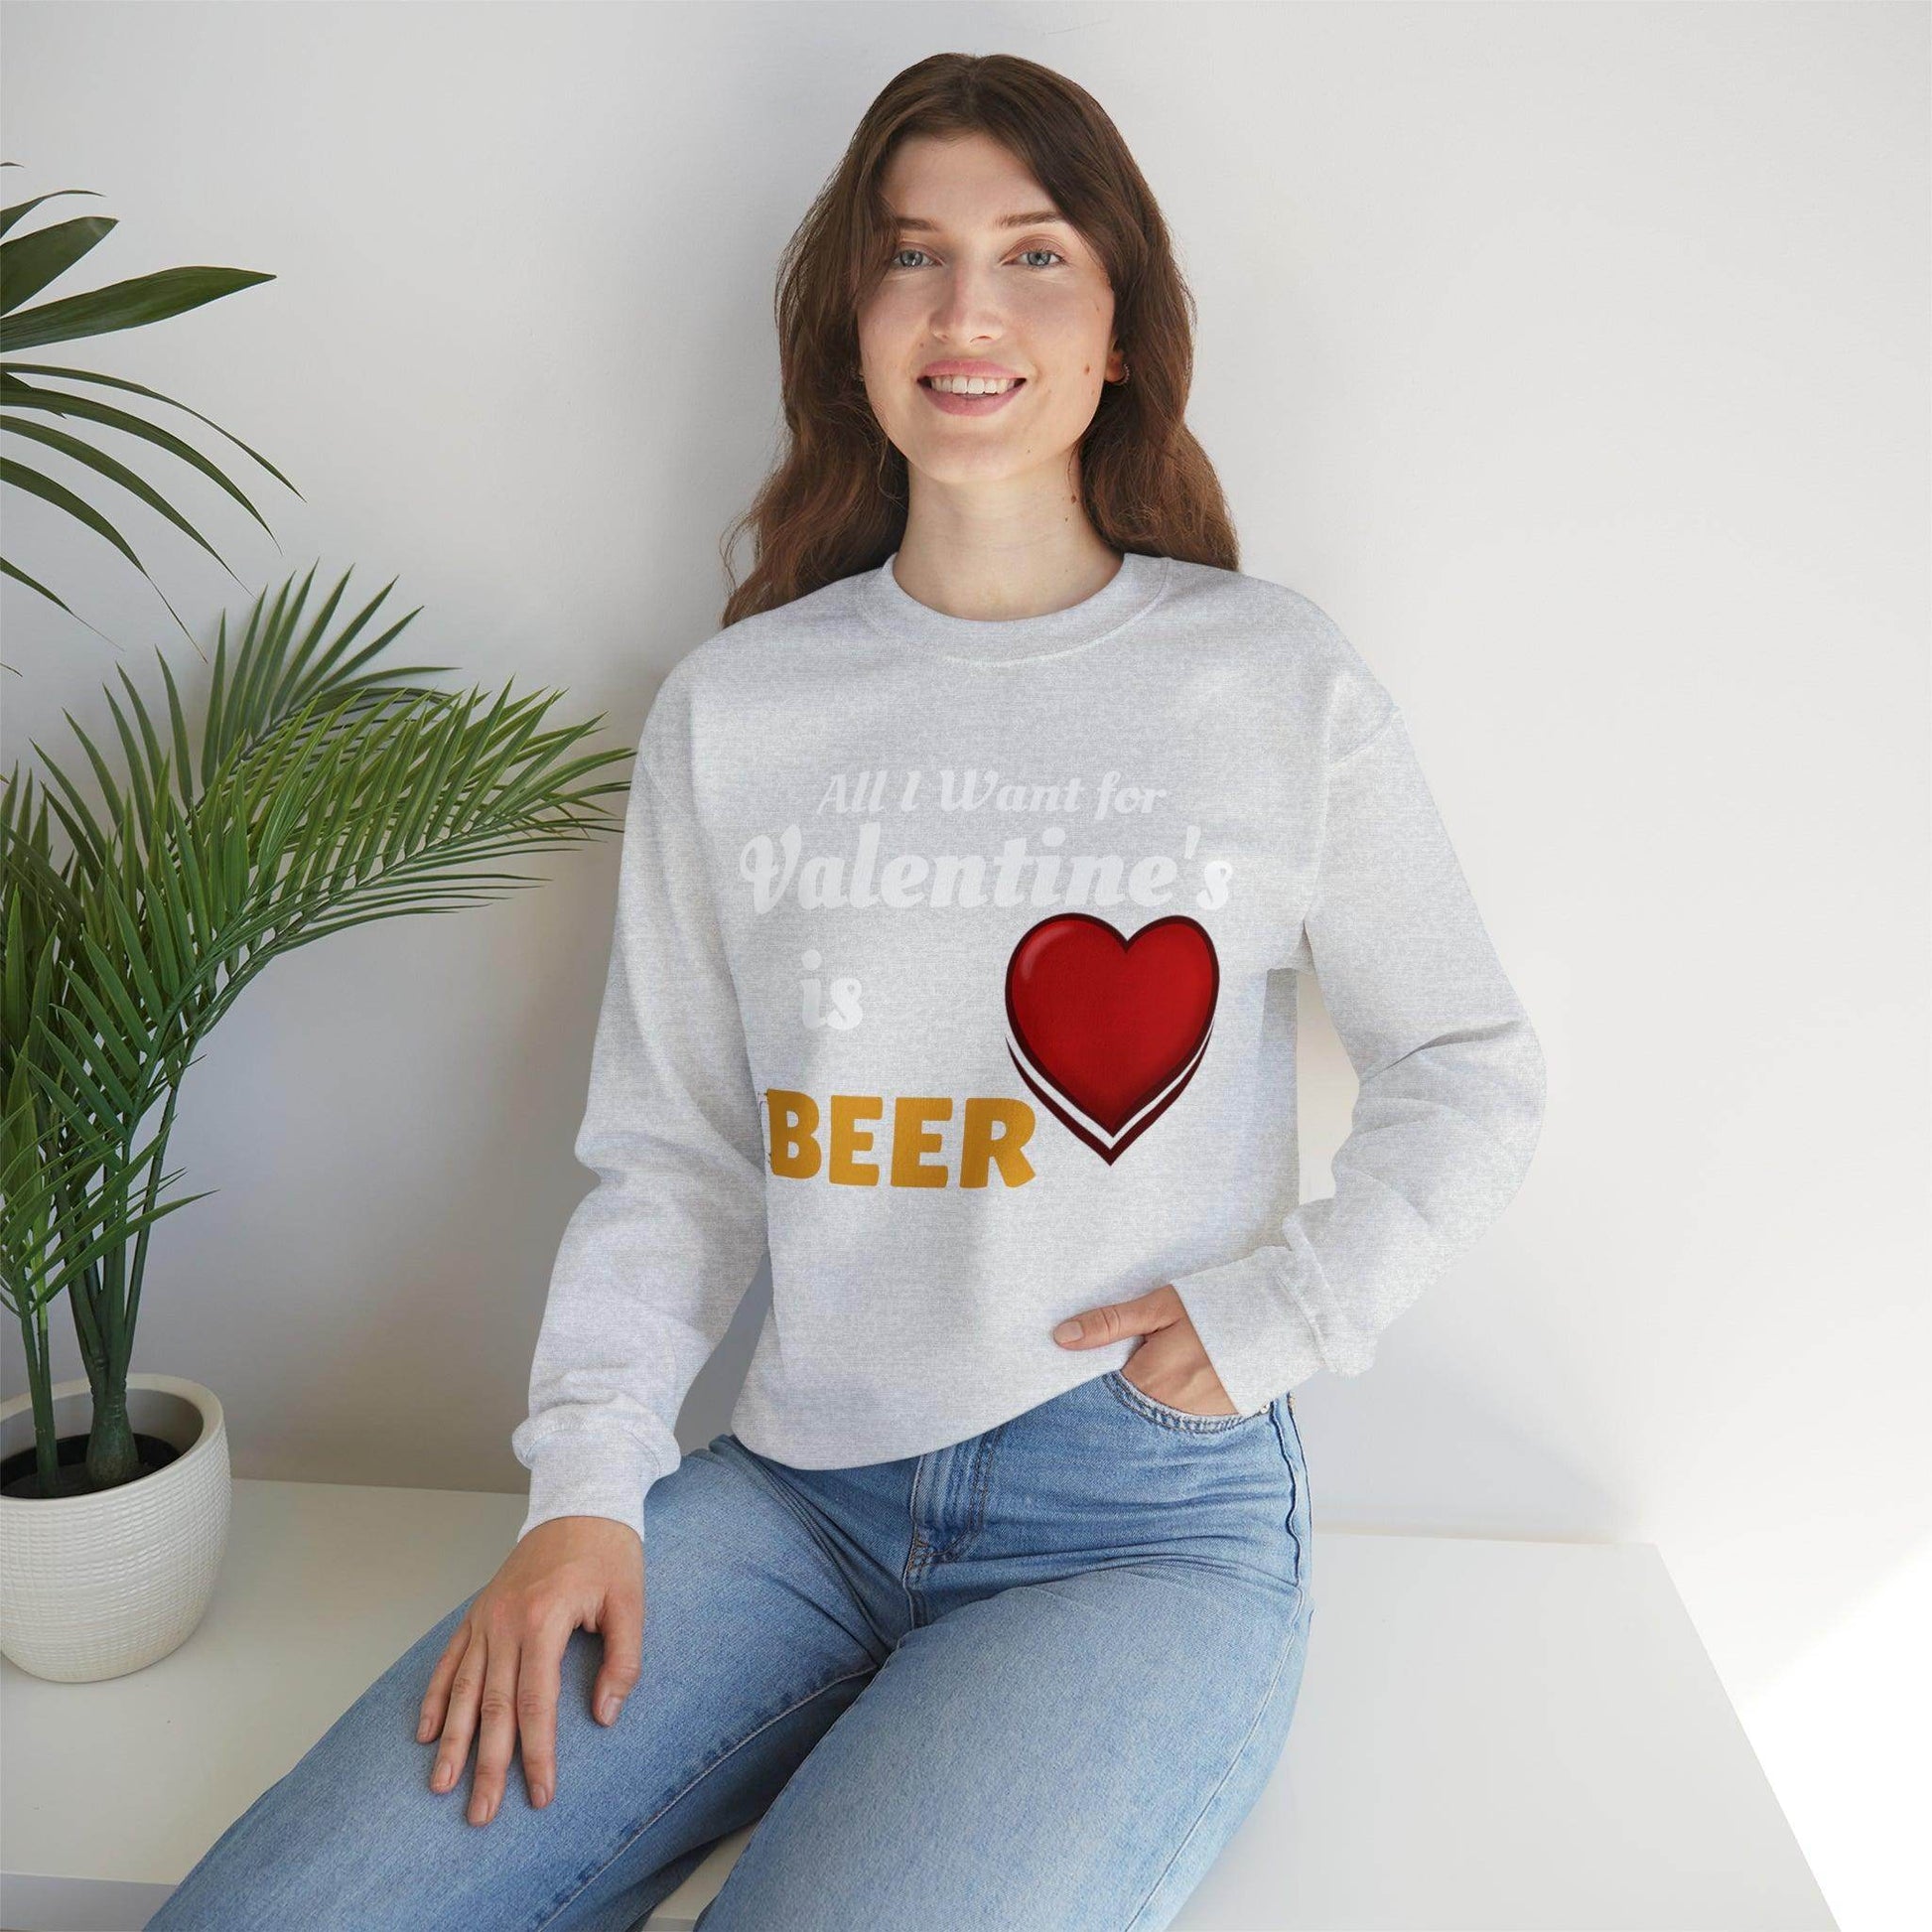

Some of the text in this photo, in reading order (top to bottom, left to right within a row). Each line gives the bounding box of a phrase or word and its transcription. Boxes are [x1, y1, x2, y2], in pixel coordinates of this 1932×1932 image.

[816, 769, 1168, 820] All I Want for
[739, 822, 1234, 915] Valentine's
[800, 948, 864, 1032] is
[766, 1088, 1037, 1189] BEER
